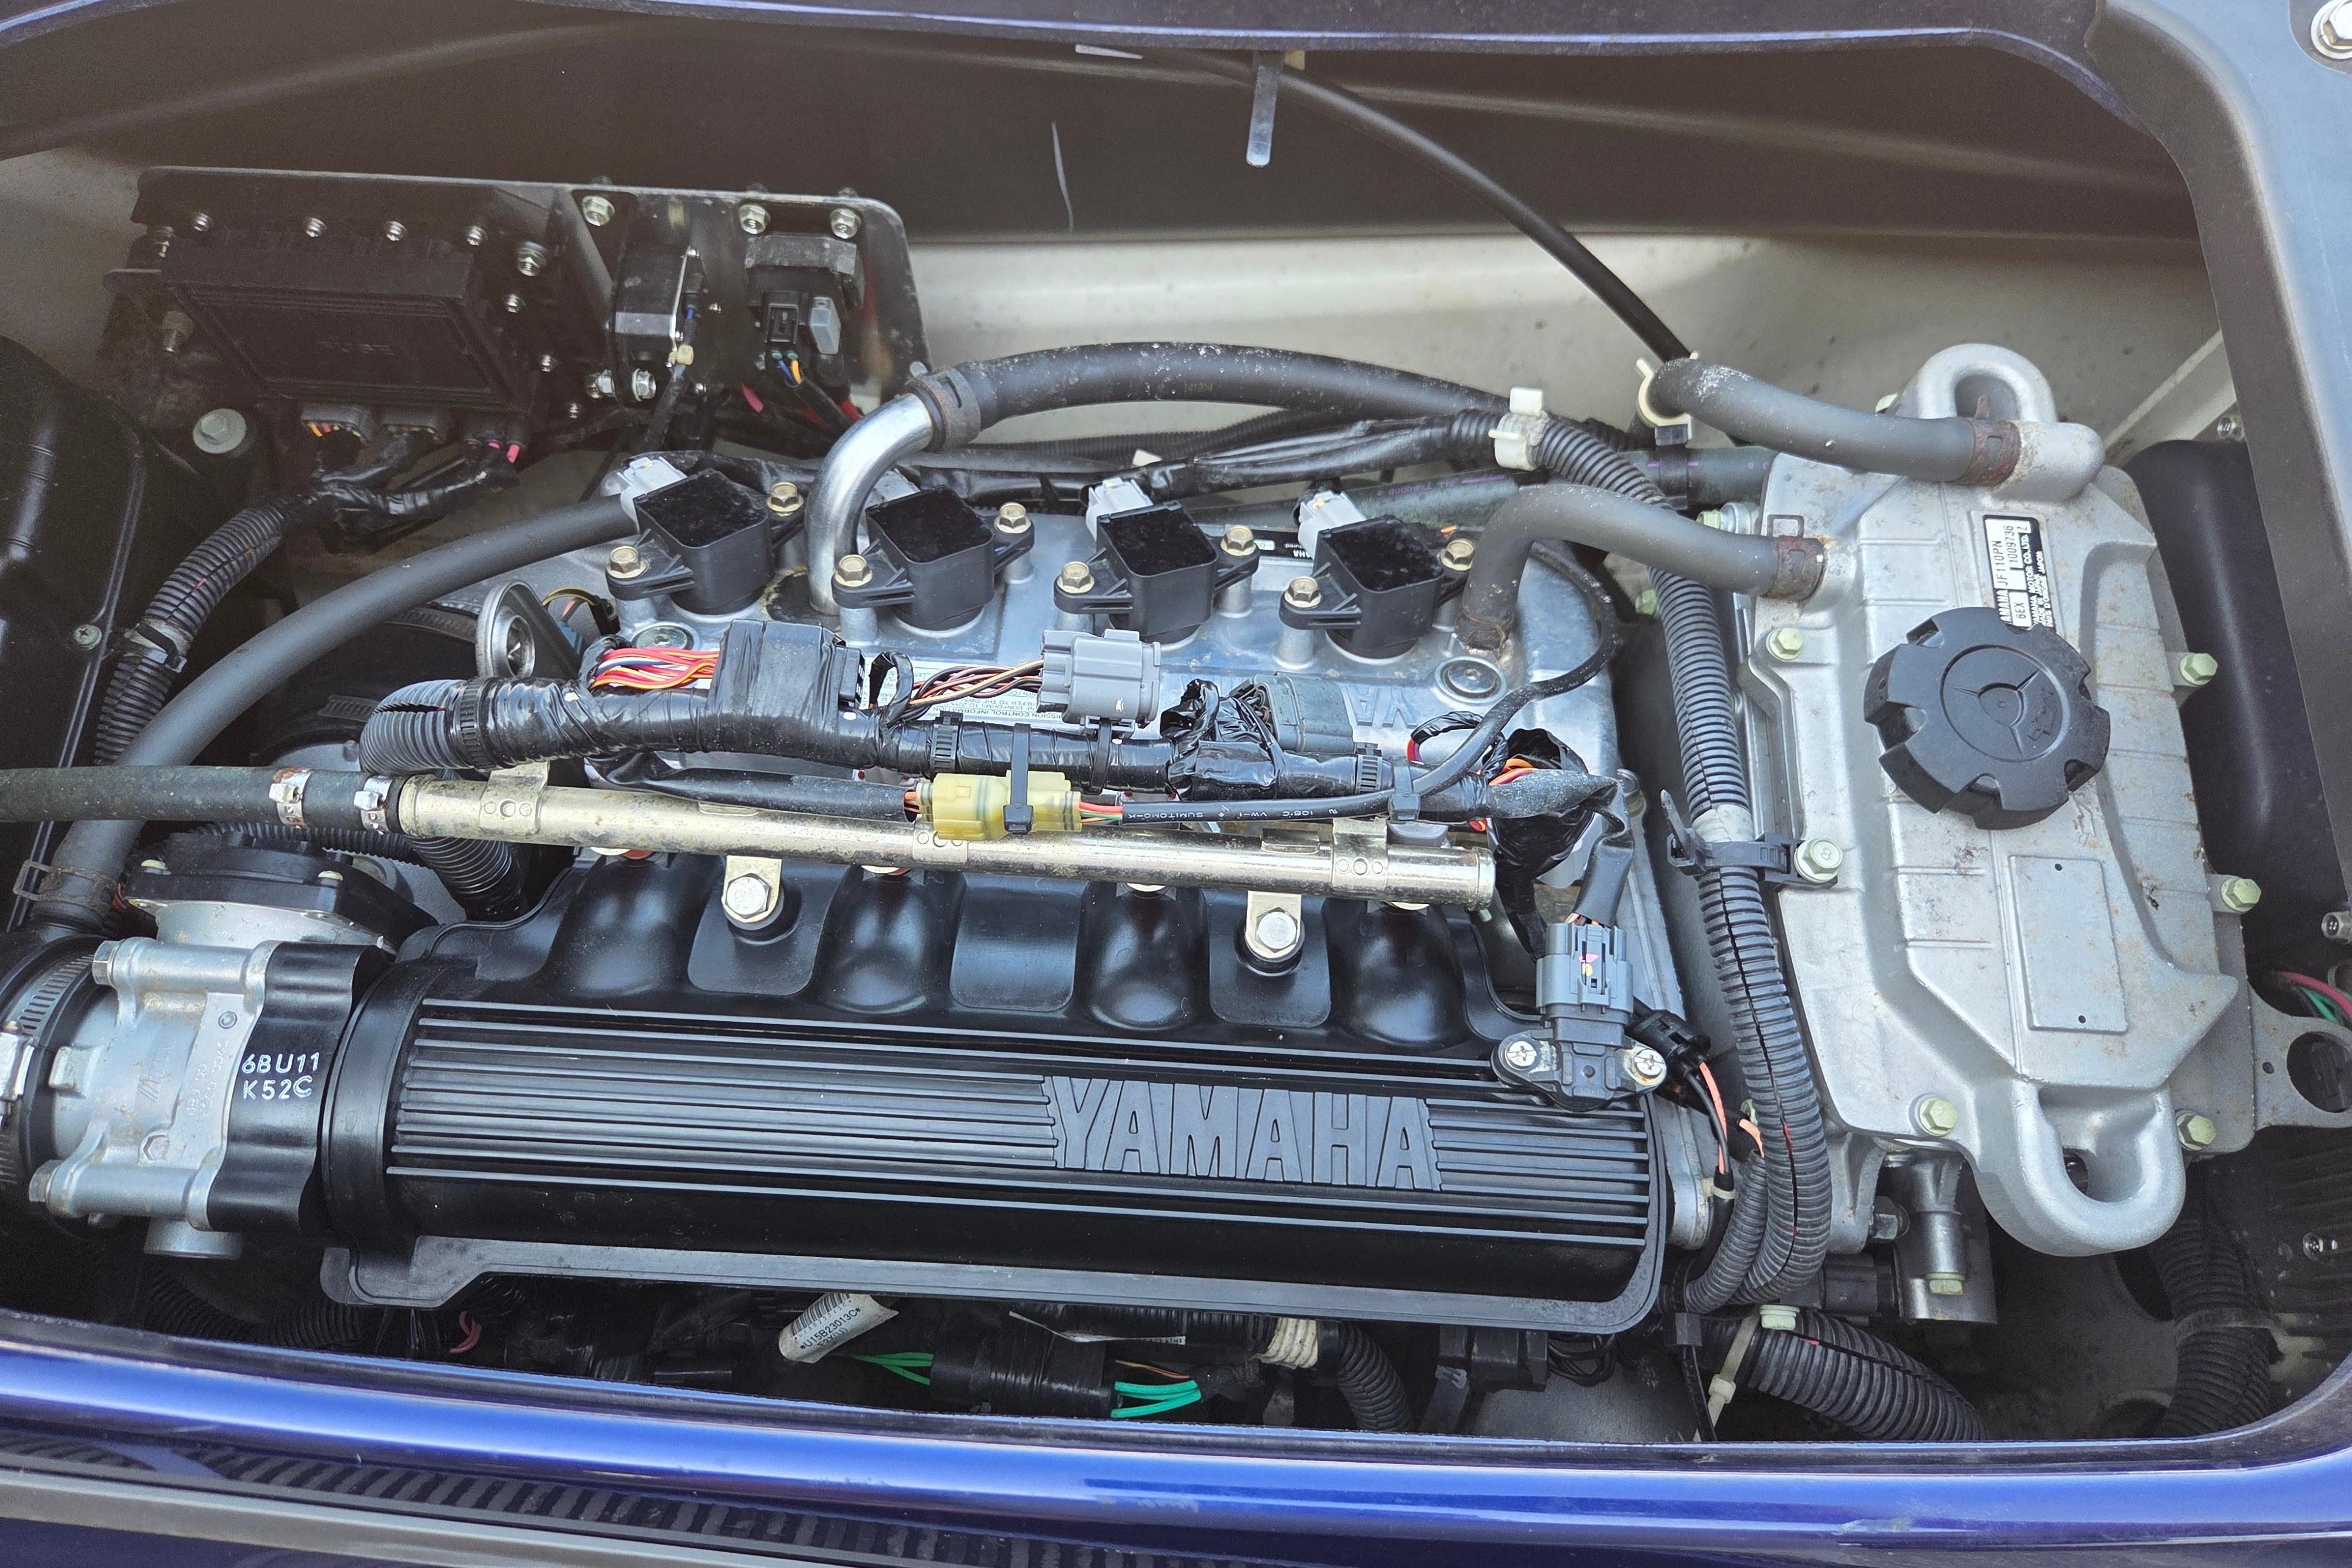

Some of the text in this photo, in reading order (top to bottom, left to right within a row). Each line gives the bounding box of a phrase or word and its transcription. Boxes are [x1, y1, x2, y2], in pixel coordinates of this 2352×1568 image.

[2003, 526, 2019, 563] 1009736
[1992, 540, 2008, 586] JF110PN
[1996, 590, 2012, 623] AMAHA
[2013, 603, 2026, 619] 6EX
[242, 1051, 320, 1074] 6BU11
[243, 1076, 313, 1100] K52C
[1051, 1075, 1435, 1190] YAMAHA
